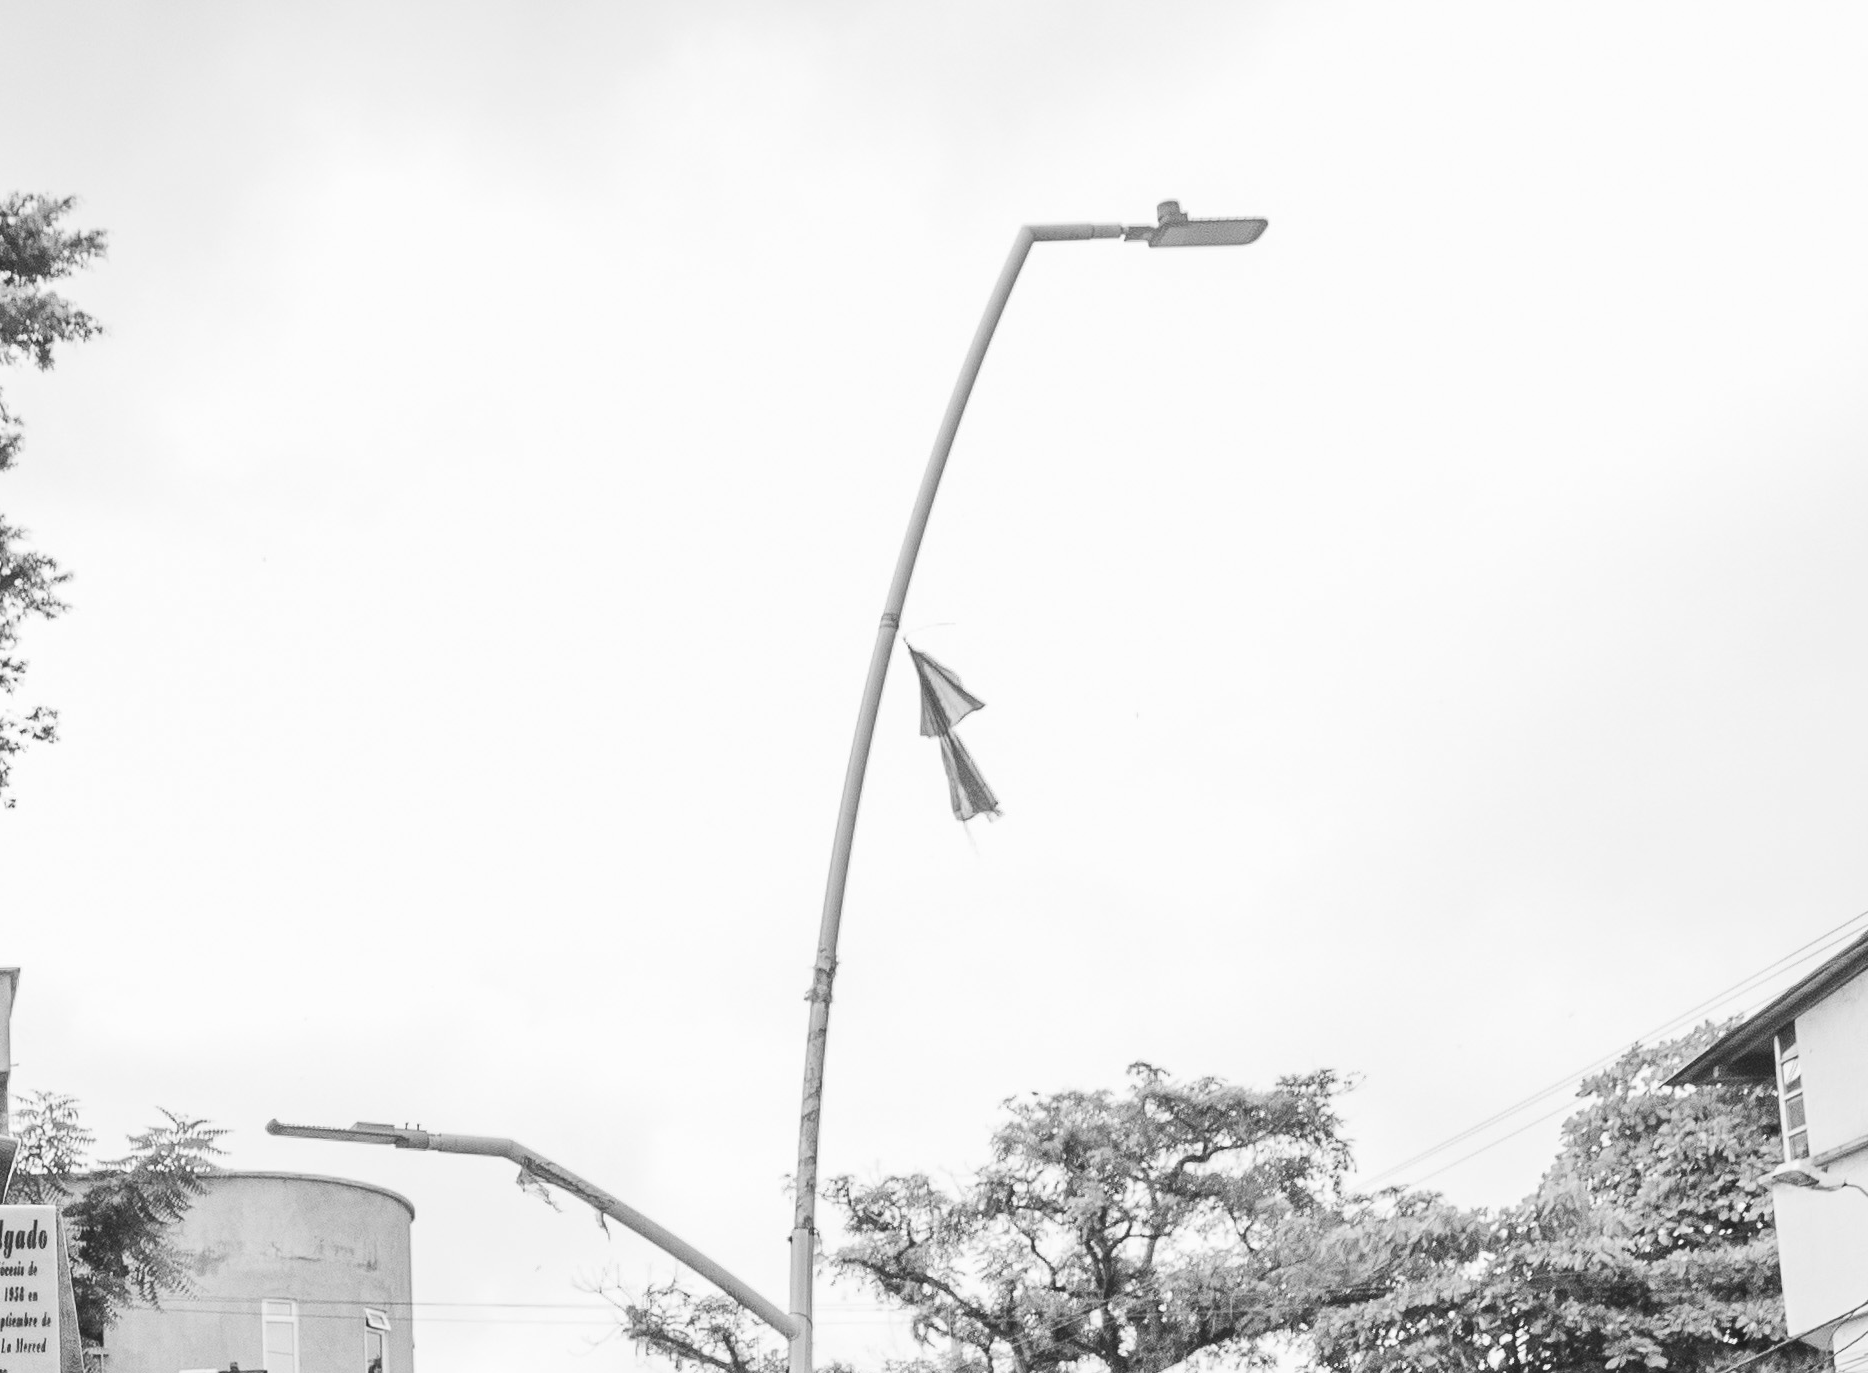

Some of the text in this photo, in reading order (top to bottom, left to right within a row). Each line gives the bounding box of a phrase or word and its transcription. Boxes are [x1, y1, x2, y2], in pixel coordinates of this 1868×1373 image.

[28, 1261, 38, 1276] de
[28, 1292, 38, 1302] en
[41, 1312, 51, 1327] de
[1, 1338, 11, 1353] La
[15, 1338, 47, 1353] Merced
